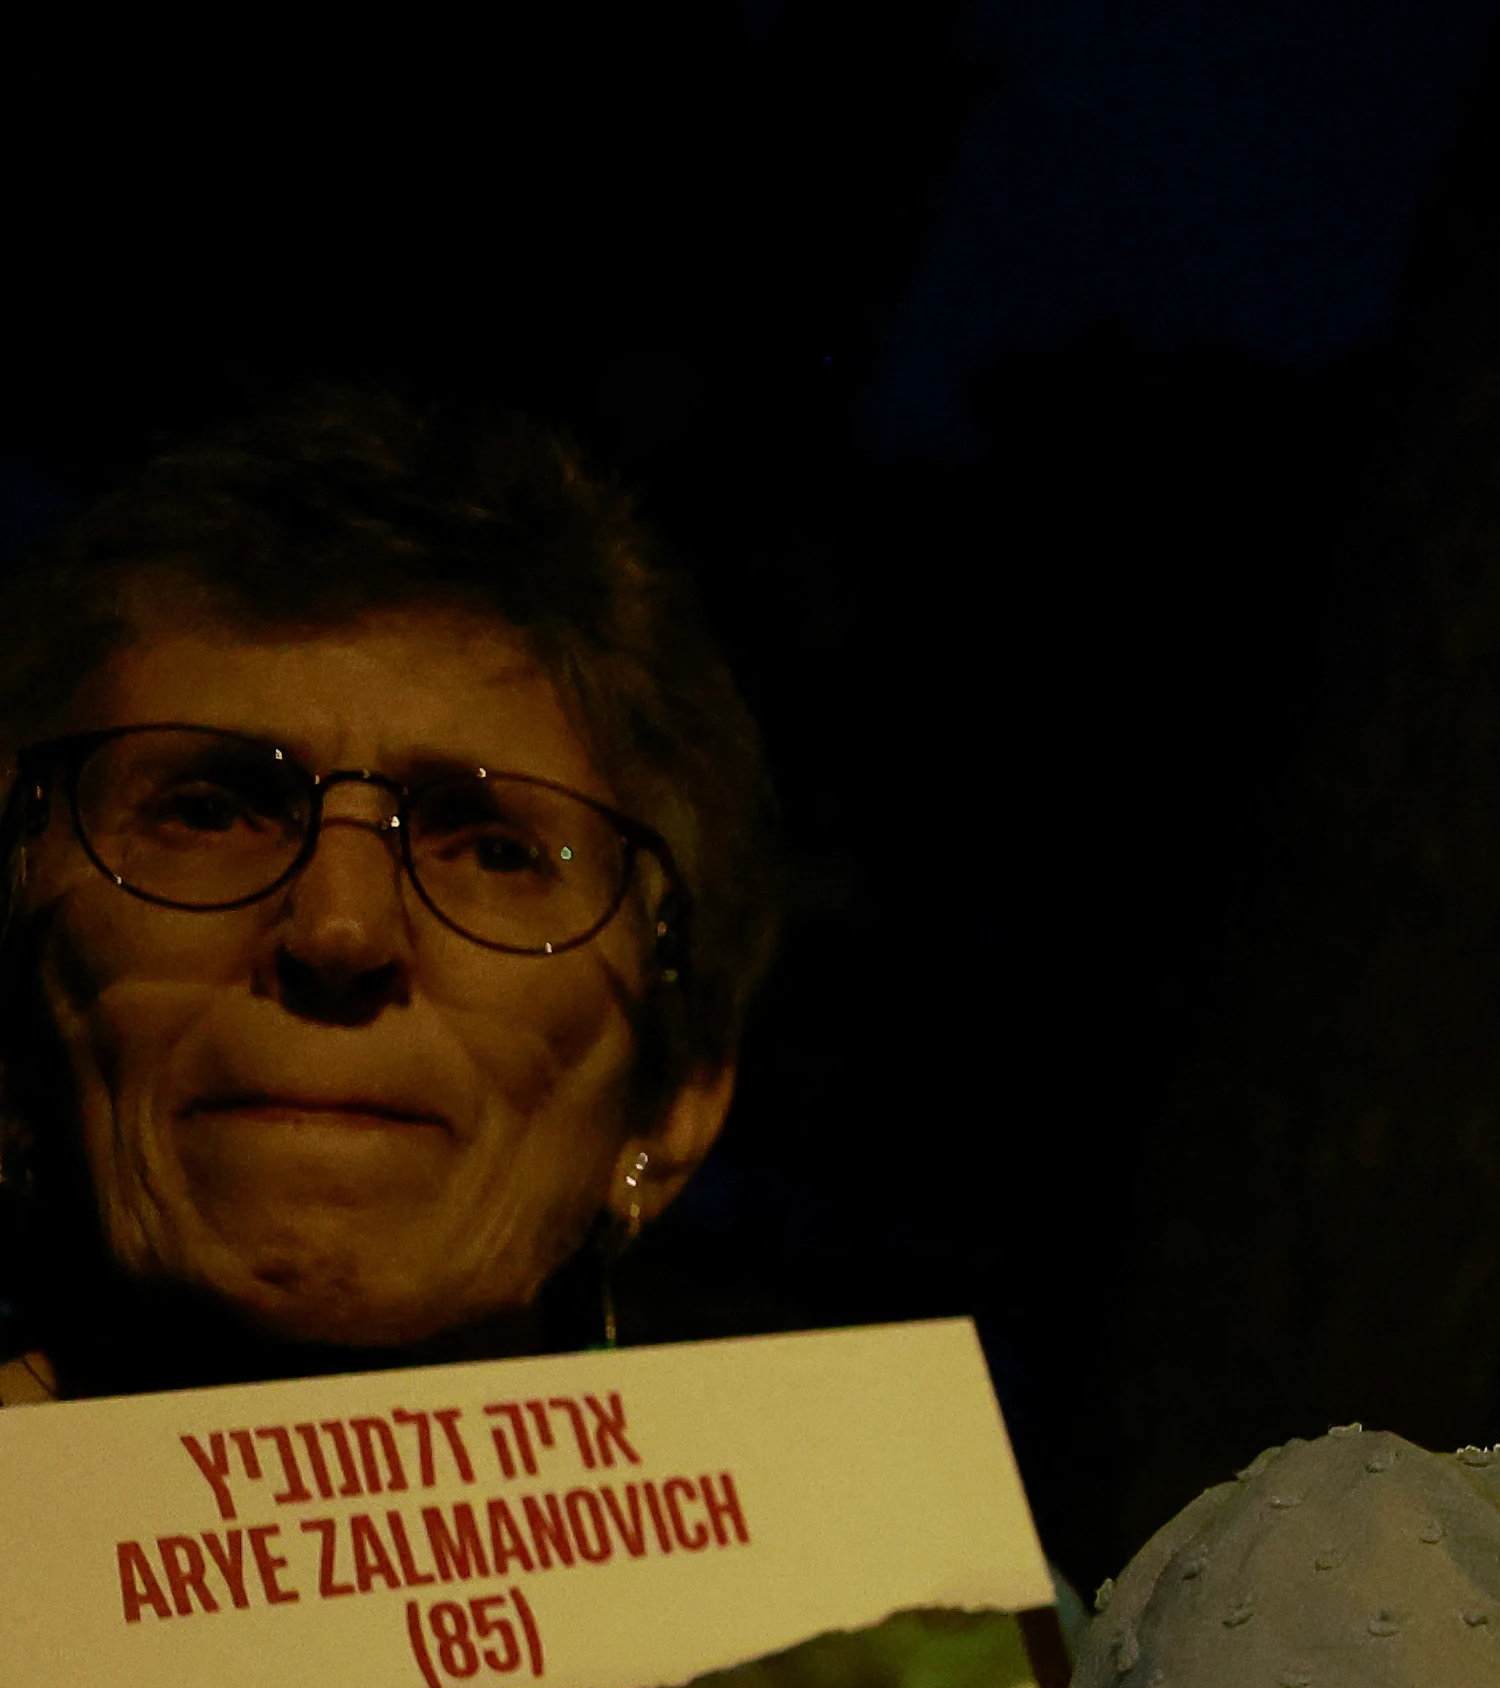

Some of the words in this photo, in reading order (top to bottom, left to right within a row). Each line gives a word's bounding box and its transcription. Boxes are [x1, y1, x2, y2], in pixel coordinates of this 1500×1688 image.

[180, 1406, 476, 1519] זלמנוביץ
[482, 1391, 642, 1479] אריה
[115, 1523, 299, 1624] ARYE
[301, 1472, 750, 1599] ZALMANOVICH
